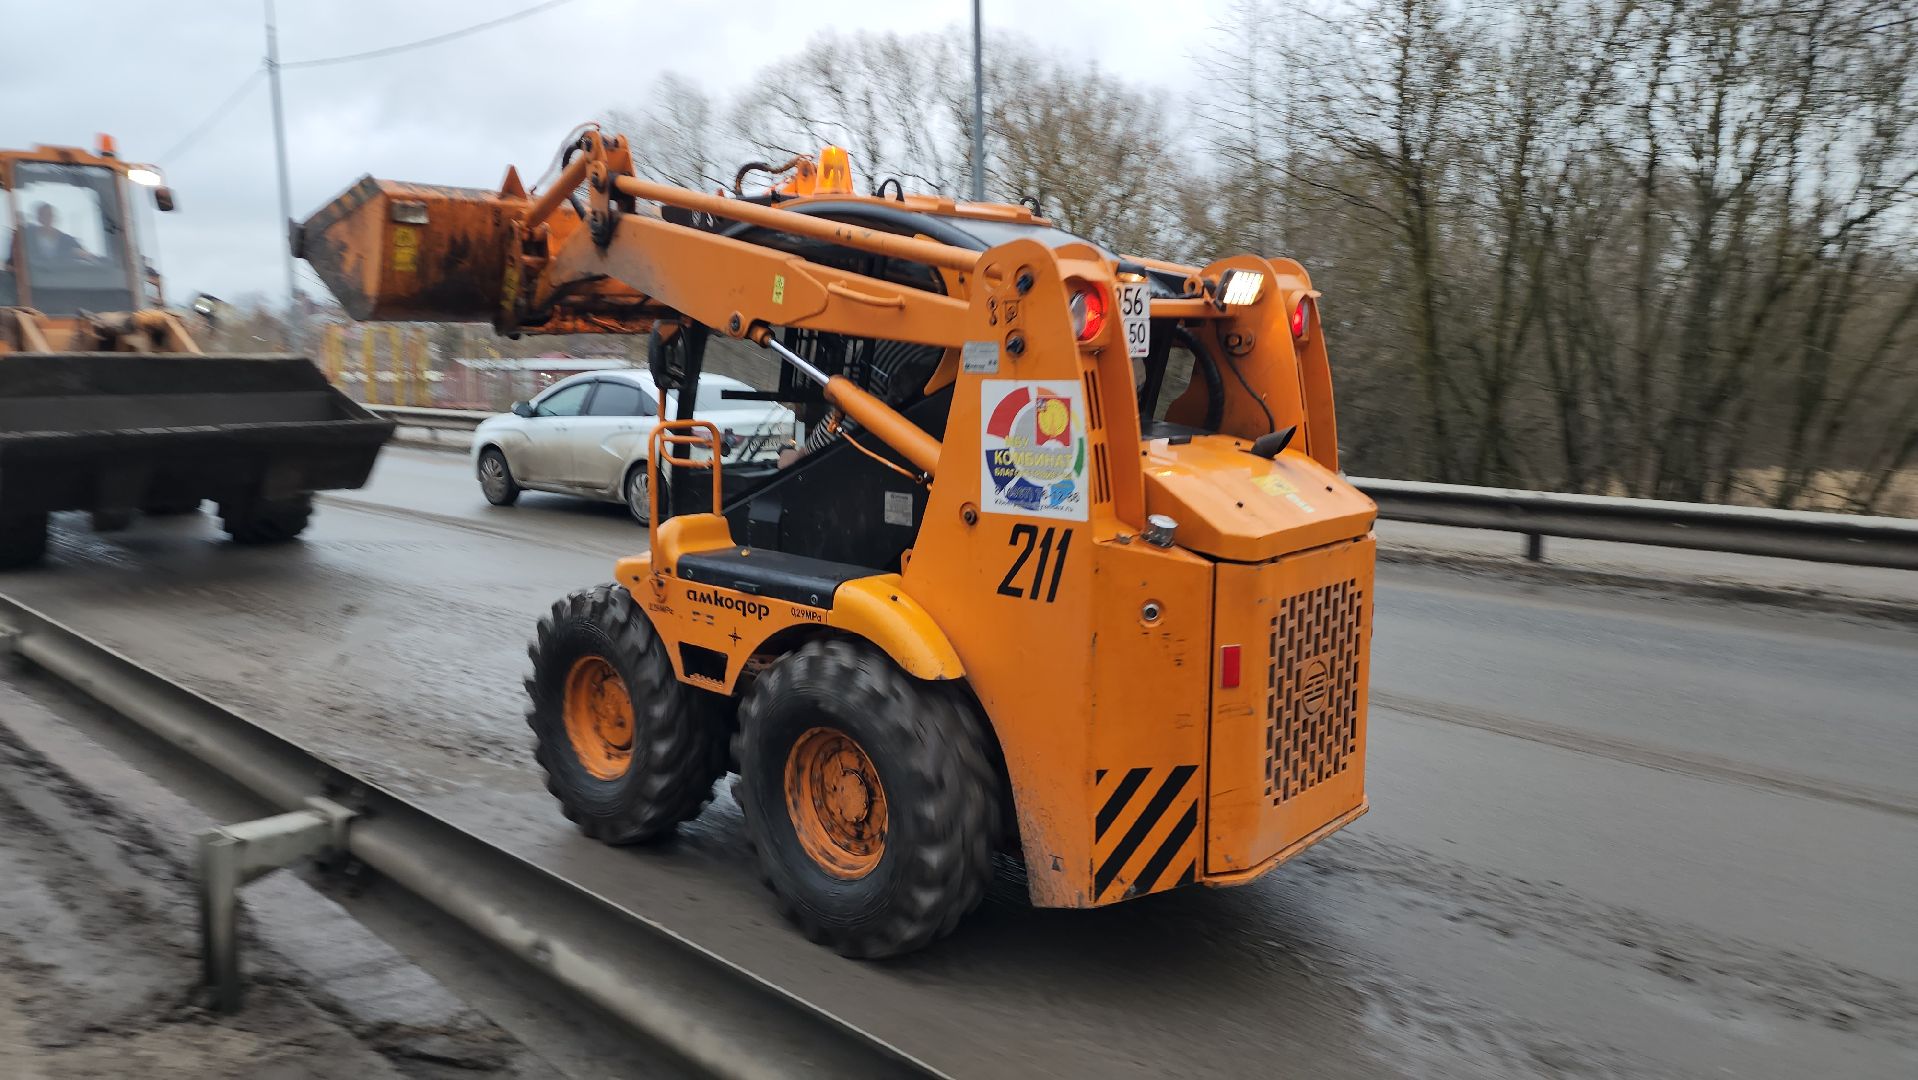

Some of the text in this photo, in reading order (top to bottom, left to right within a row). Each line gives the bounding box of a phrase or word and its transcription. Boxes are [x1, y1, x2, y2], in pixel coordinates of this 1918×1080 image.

[1129, 323, 1146, 344] 50
[995, 450, 1073, 468] КОМБИНАТ
[997, 523, 1073, 603] 211
